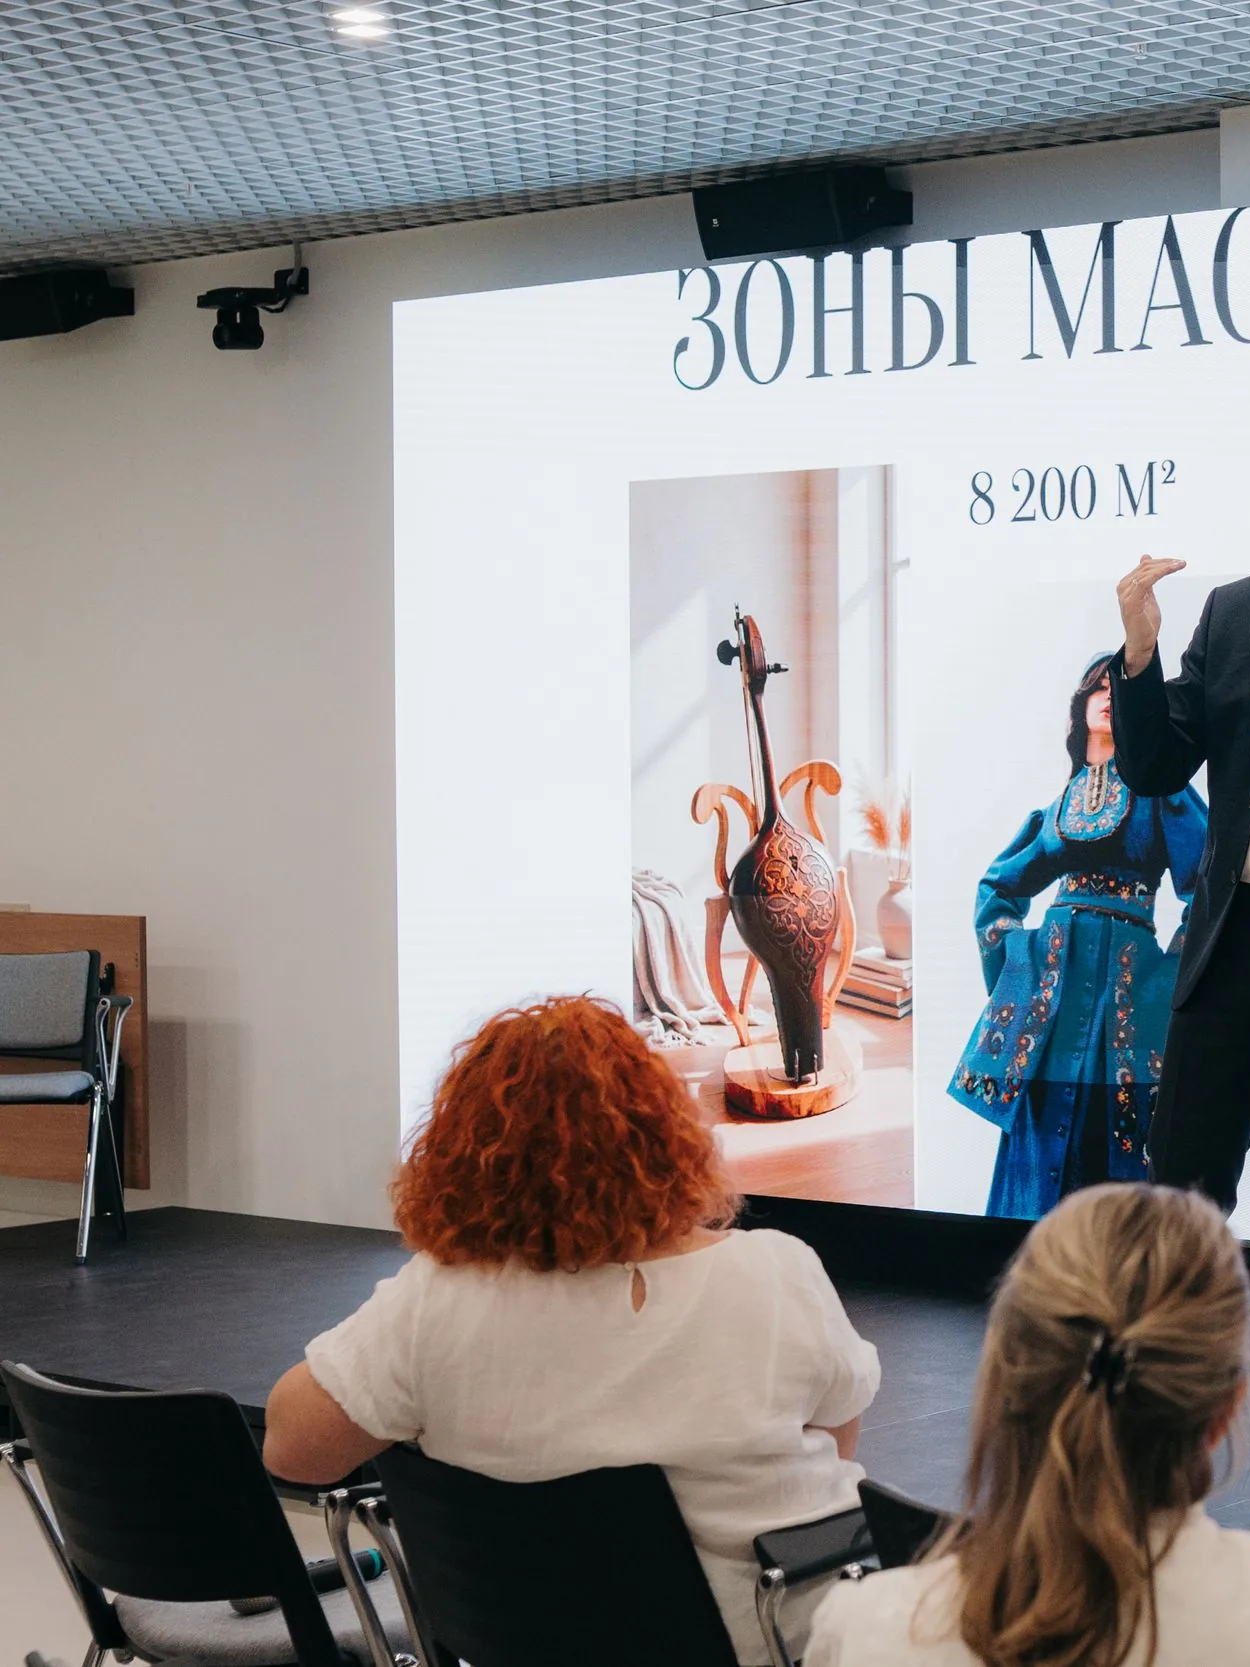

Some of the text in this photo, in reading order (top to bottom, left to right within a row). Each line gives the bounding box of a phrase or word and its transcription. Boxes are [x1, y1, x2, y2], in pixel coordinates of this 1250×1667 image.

[674, 237, 977, 391] ЗОНЫ
[969, 471, 995, 525] 8
[1011, 464, 1096, 522] 200
